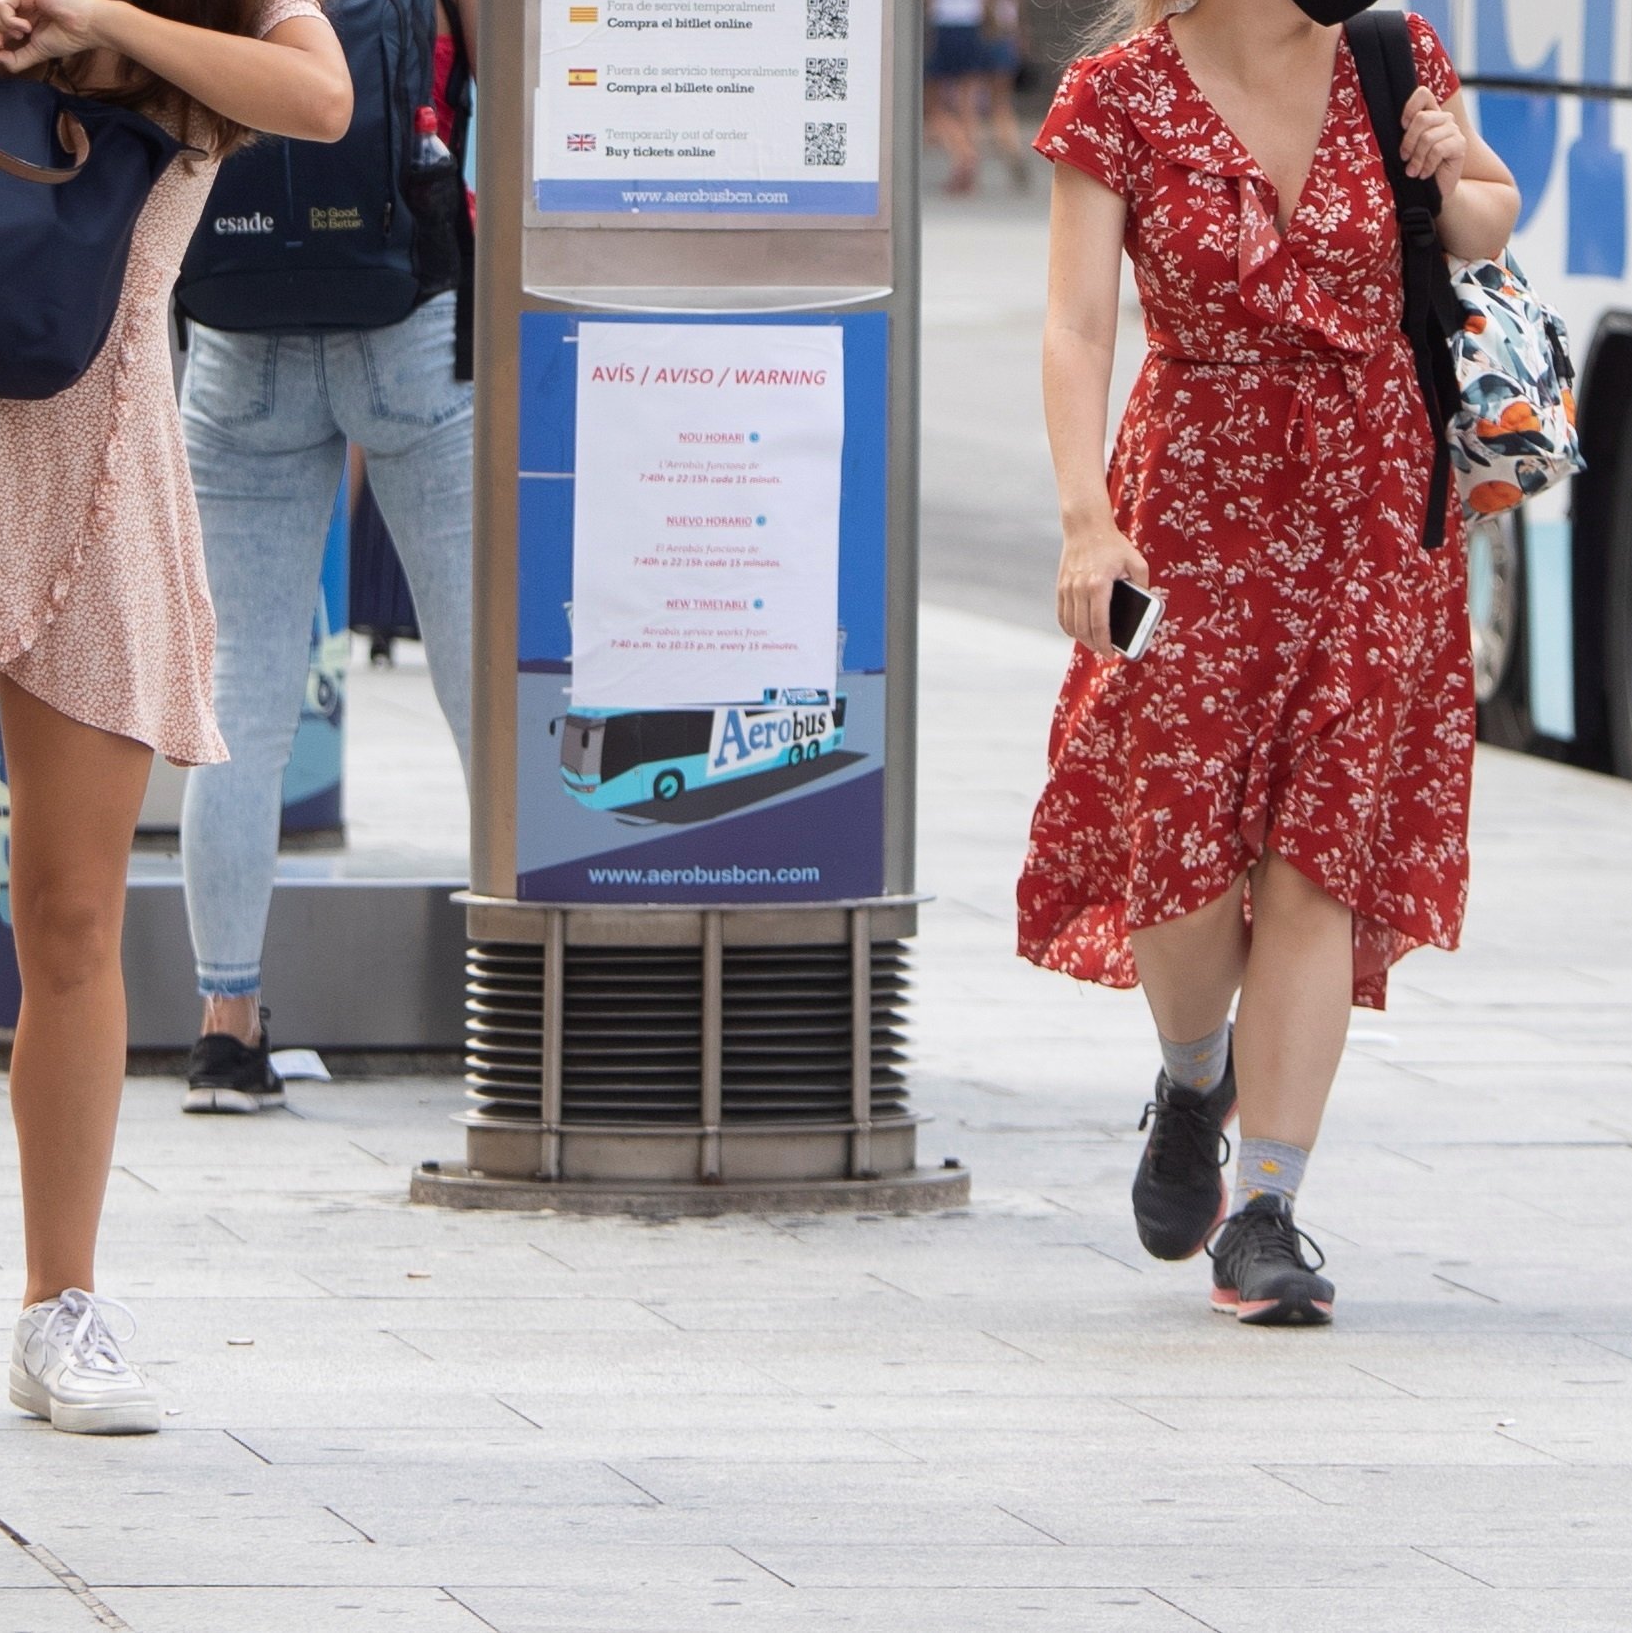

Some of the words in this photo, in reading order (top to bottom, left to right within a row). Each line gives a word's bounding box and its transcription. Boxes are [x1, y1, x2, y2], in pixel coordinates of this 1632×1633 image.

[607, 0, 633, 12] Fora
[636, 1, 652, 12] de
[655, 1, 691, 12] servei
[694, 1, 776, 15] temporalment
[607, 18, 660, 33] Compra
[664, 18, 673, 29] el
[715, 19, 753, 30] online
[606, 65, 640, 76] Fuera
[642, 65, 658, 76] de
[661, 65, 708, 77] servicio
[710, 66, 800, 79] temporalmente
[607, 82, 658, 97] Compra
[662, 82, 671, 94] el
[675, 82, 712, 94] billete
[716, 83, 754, 94] online
[606, 129, 677, 143] Temporarily
[681, 130, 699, 140] out
[703, 129, 715, 140] of
[716, 130, 749, 141] order
[606, 147, 629, 161] Buy
[633, 147, 673, 158] tickets
[677, 147, 716, 158] online
[622, 189, 788, 204] www.aerobusbcn.com
[310, 207, 326, 218] Do
[328, 207, 360, 217] Good.
[214, 211, 274, 235] esade
[311, 218, 327, 229] Do
[592, 363, 635, 383] AVÍS
[641, 366, 650, 385] /
[655, 368, 714, 384] AVISO
[718, 368, 729, 387] /
[735, 369, 826, 385] WARNING
[679, 433, 703, 443] NOU
[706, 433, 745, 443] HORARI
[706, 460, 745, 472] funciona
[748, 461, 760, 470] de
[668, 476, 675, 484] a
[677, 474, 709, 484] 22:15h
[711, 475, 733, 484] cada
[736, 475, 748, 485] 15
[667, 516, 703, 526] NUEVO
[706, 516, 752, 526] HORARIO
[655, 544, 664, 554] El
[706, 545, 745, 556] funciona
[748, 545, 759, 554] de
[662, 559, 669, 567] a
[705, 558, 727, 568] cada
[730, 558, 741, 568] 15
[666, 599, 691, 610] NEW
[693, 600, 748, 610] TIMETABLE
[684, 627, 714, 637] service
[717, 627, 743, 637] works
[657, 641, 667, 650] to
[749, 641, 761, 651] 15
[715, 709, 827, 768] Aerobus
[588, 865, 820, 885] www.aerobusbcn.com
